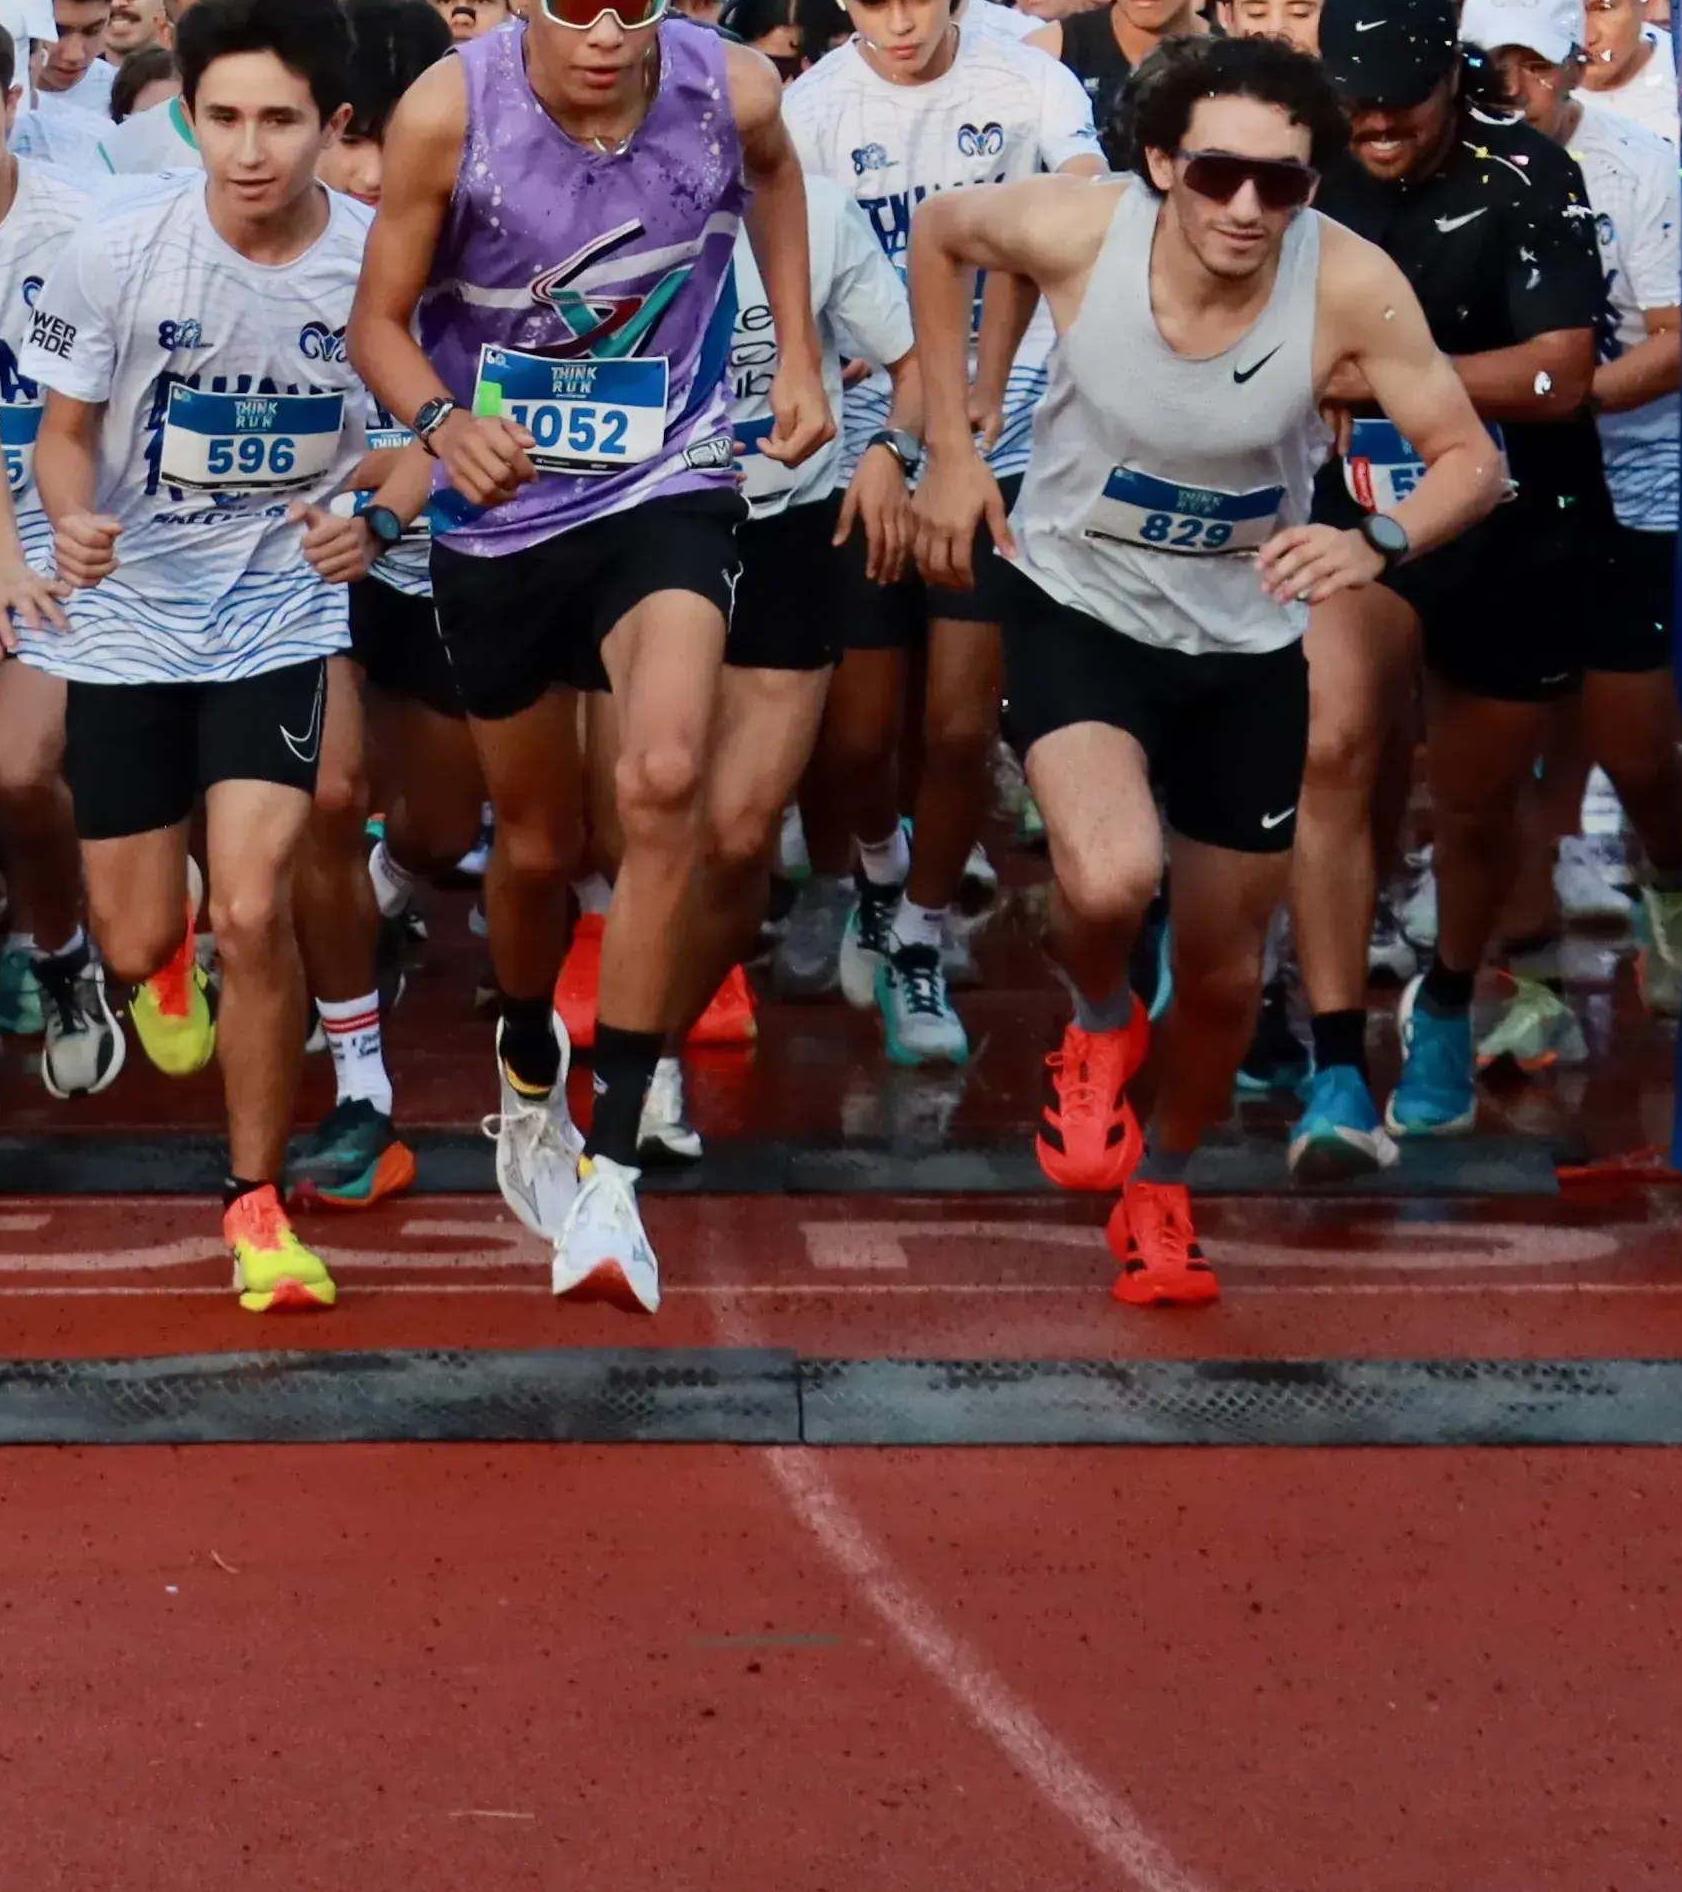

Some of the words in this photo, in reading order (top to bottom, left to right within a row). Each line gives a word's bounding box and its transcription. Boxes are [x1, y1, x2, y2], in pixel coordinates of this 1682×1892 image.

[30, 310, 77, 344] WER
[30, 328, 72, 362] ADE
[551, 367, 598, 381] THINK
[552, 381, 592, 394] RUN
[233, 402, 278, 416] THINK
[511, 406, 628, 456] 1052
[207, 438, 296, 475] 596
[1138, 513, 1233, 550] 829
